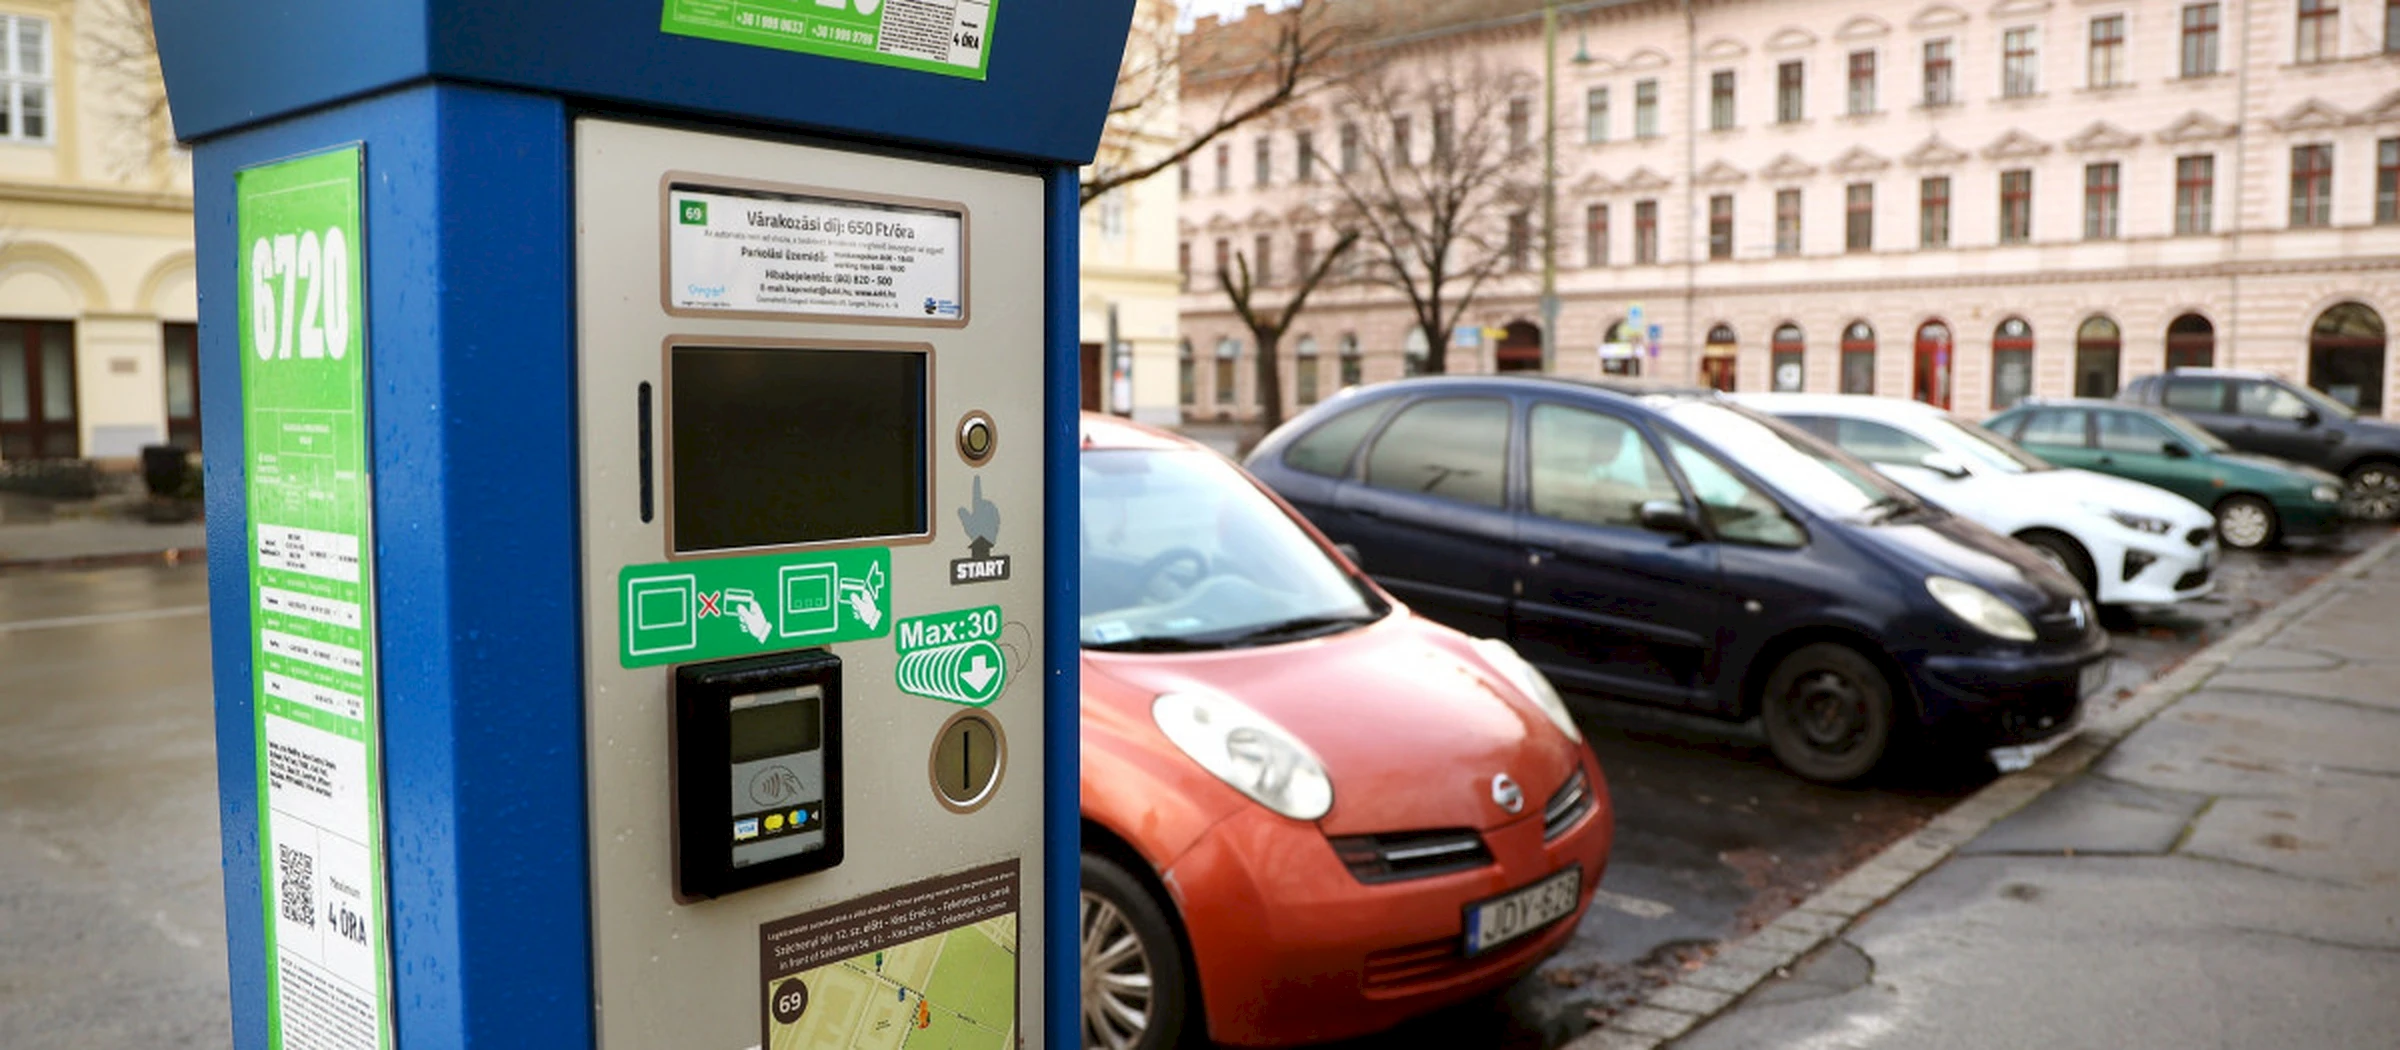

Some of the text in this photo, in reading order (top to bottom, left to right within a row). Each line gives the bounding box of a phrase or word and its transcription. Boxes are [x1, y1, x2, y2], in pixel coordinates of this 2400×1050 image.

[685, 208, 702, 221] 69
[747, 209, 915, 240] Várakozási díj: 650 Ft/óra
[741, 246, 783, 260] Parkolási
[877, 275, 893, 287] 500
[252, 225, 349, 361] 6720
[957, 560, 1005, 579] START
[901, 610, 998, 649] Max:30
[328, 901, 367, 947] 4 ÓRA
[774, 935, 819, 957] Széchenyi
[778, 991, 802, 1014] 69
